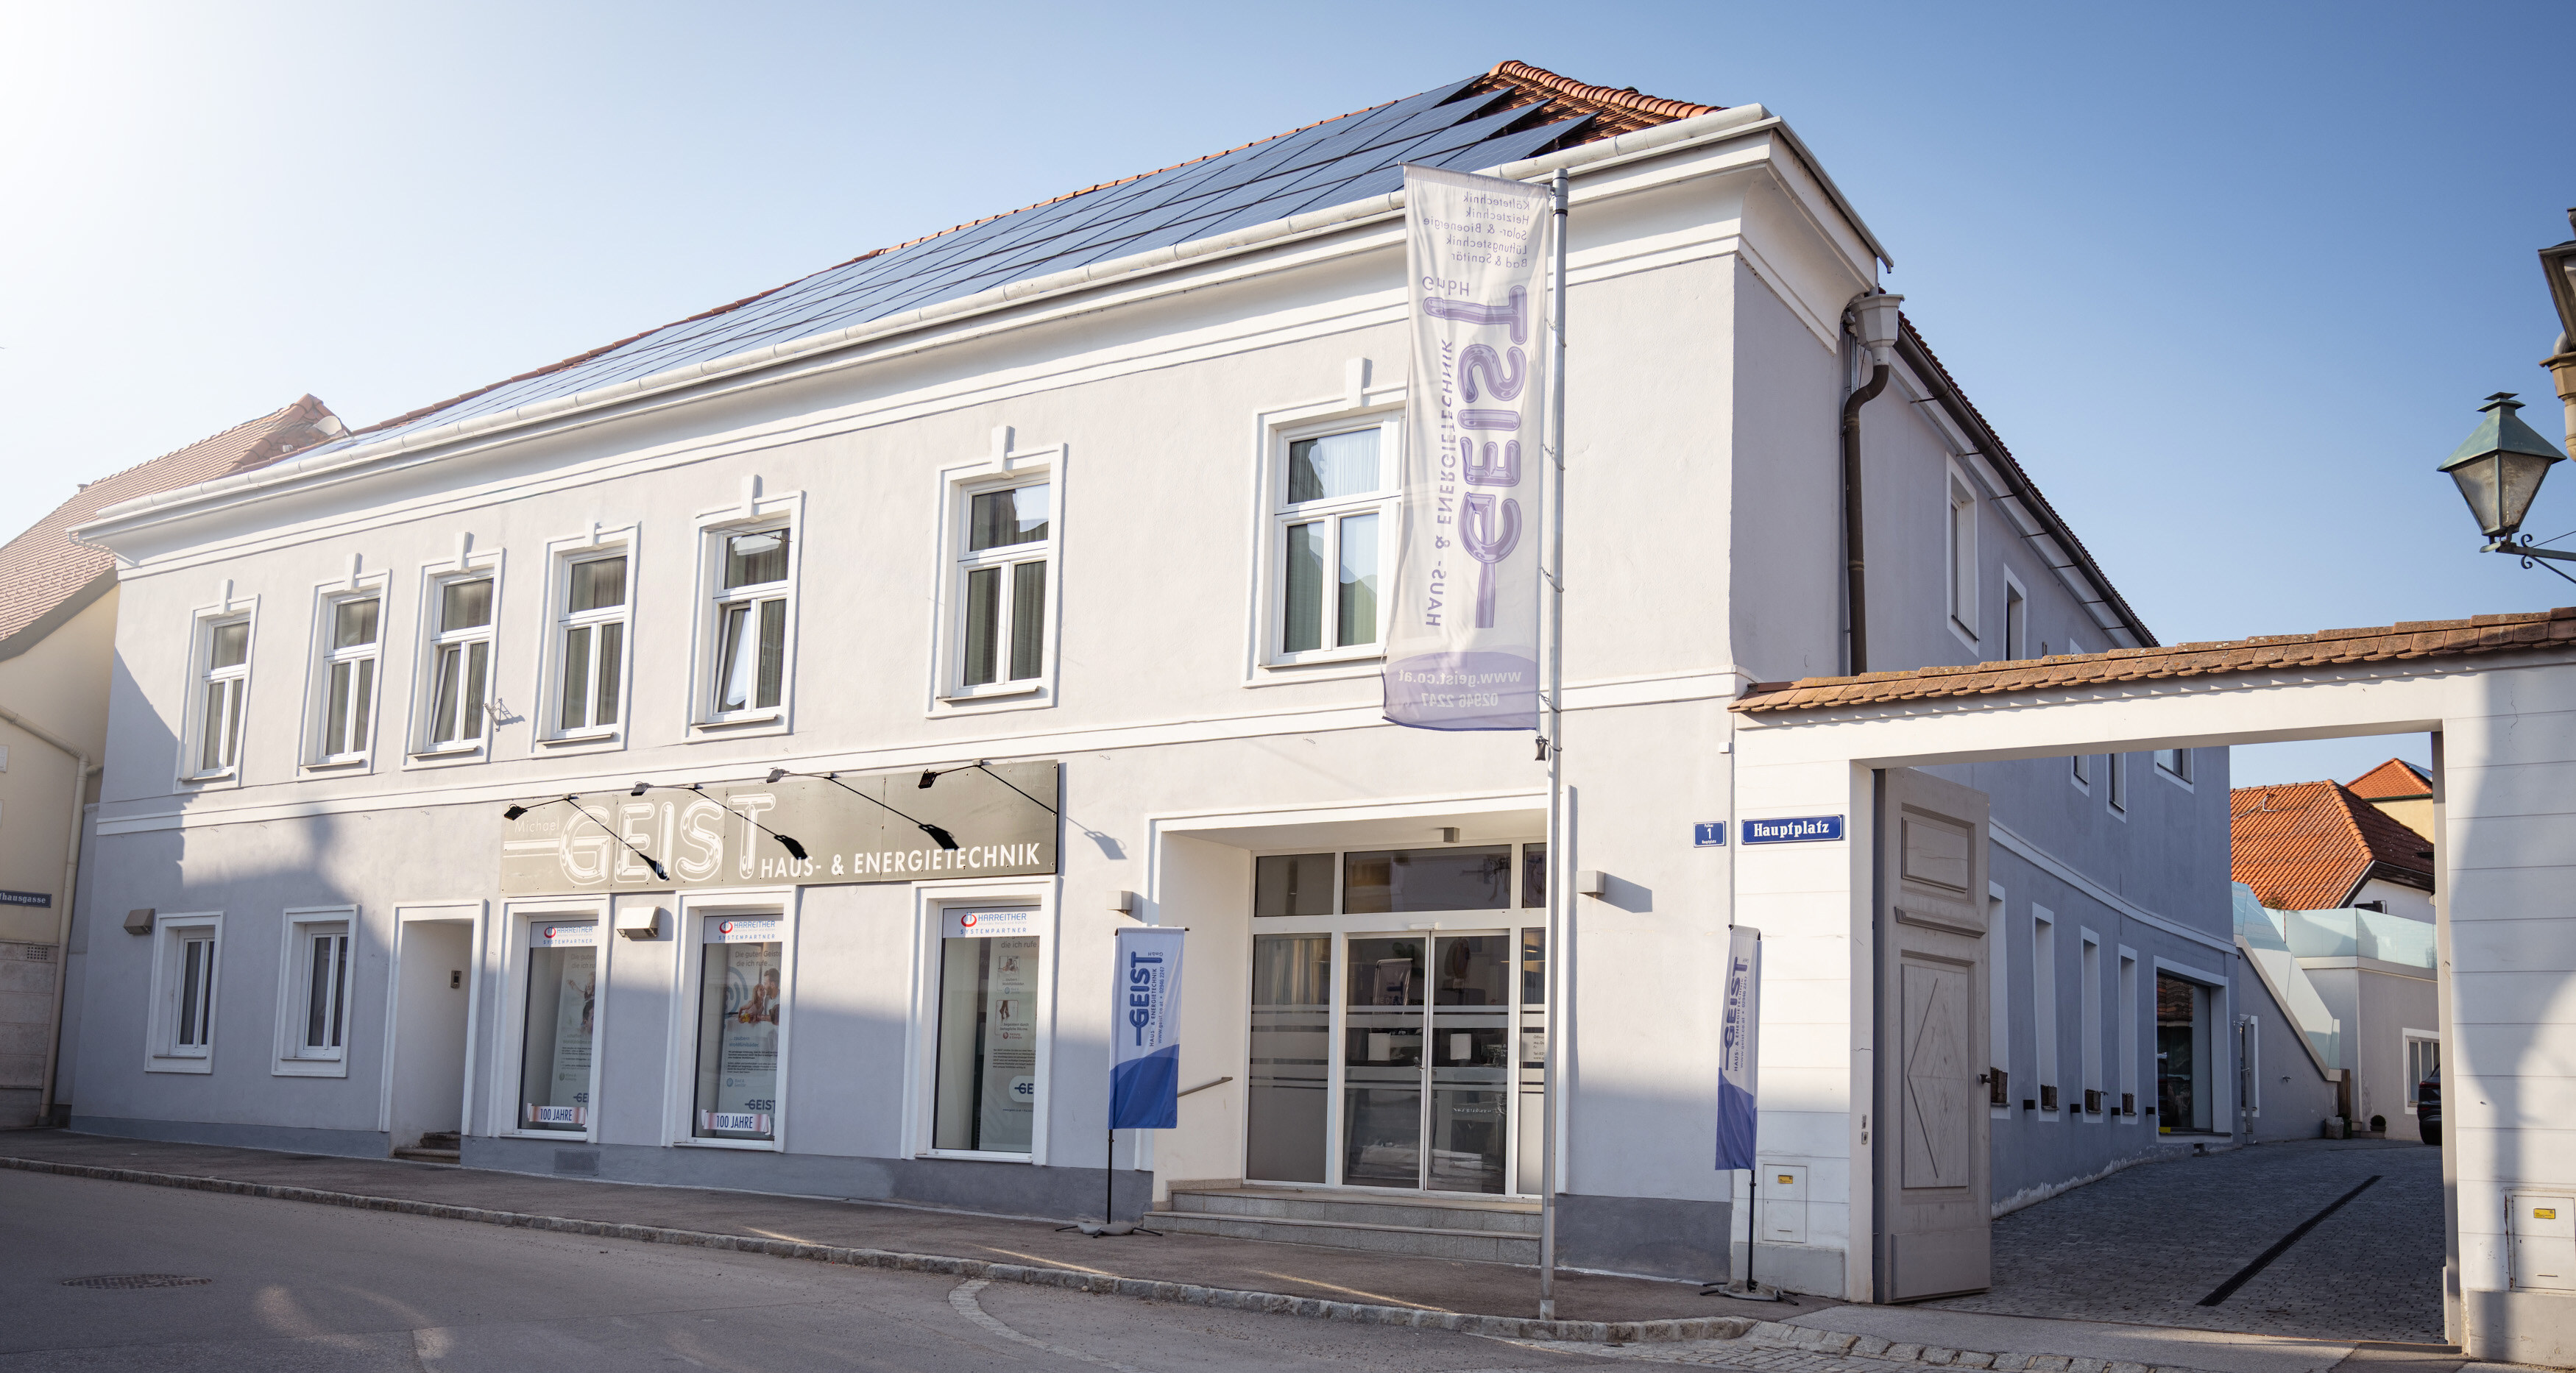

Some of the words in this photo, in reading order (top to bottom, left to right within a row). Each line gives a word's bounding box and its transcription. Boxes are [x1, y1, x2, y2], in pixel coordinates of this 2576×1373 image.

[514, 819, 559, 833] Michael
[1753, 820, 1830, 838] Hauptplatz
[559, 793, 776, 885] GEIST
[1707, 828, 1711, 839] 1
[761, 856, 821, 879] HAUS-
[832, 854, 844, 876] &
[854, 842, 1040, 874] ENERGIETECHNIK
[978, 912, 1027, 921] HARREITHER
[556, 926, 593, 934] HARREITHER
[734, 920, 776, 929] HARREITHER
[1129, 951, 1163, 1029] GEIST
[1724, 957, 1748, 1049] GEIST
[540, 1108, 551, 1121] 100
[553, 1109, 573, 1121] JAHRE
[716, 1115, 729, 1128] 100
[731, 1115, 754, 1129] JAHRE
